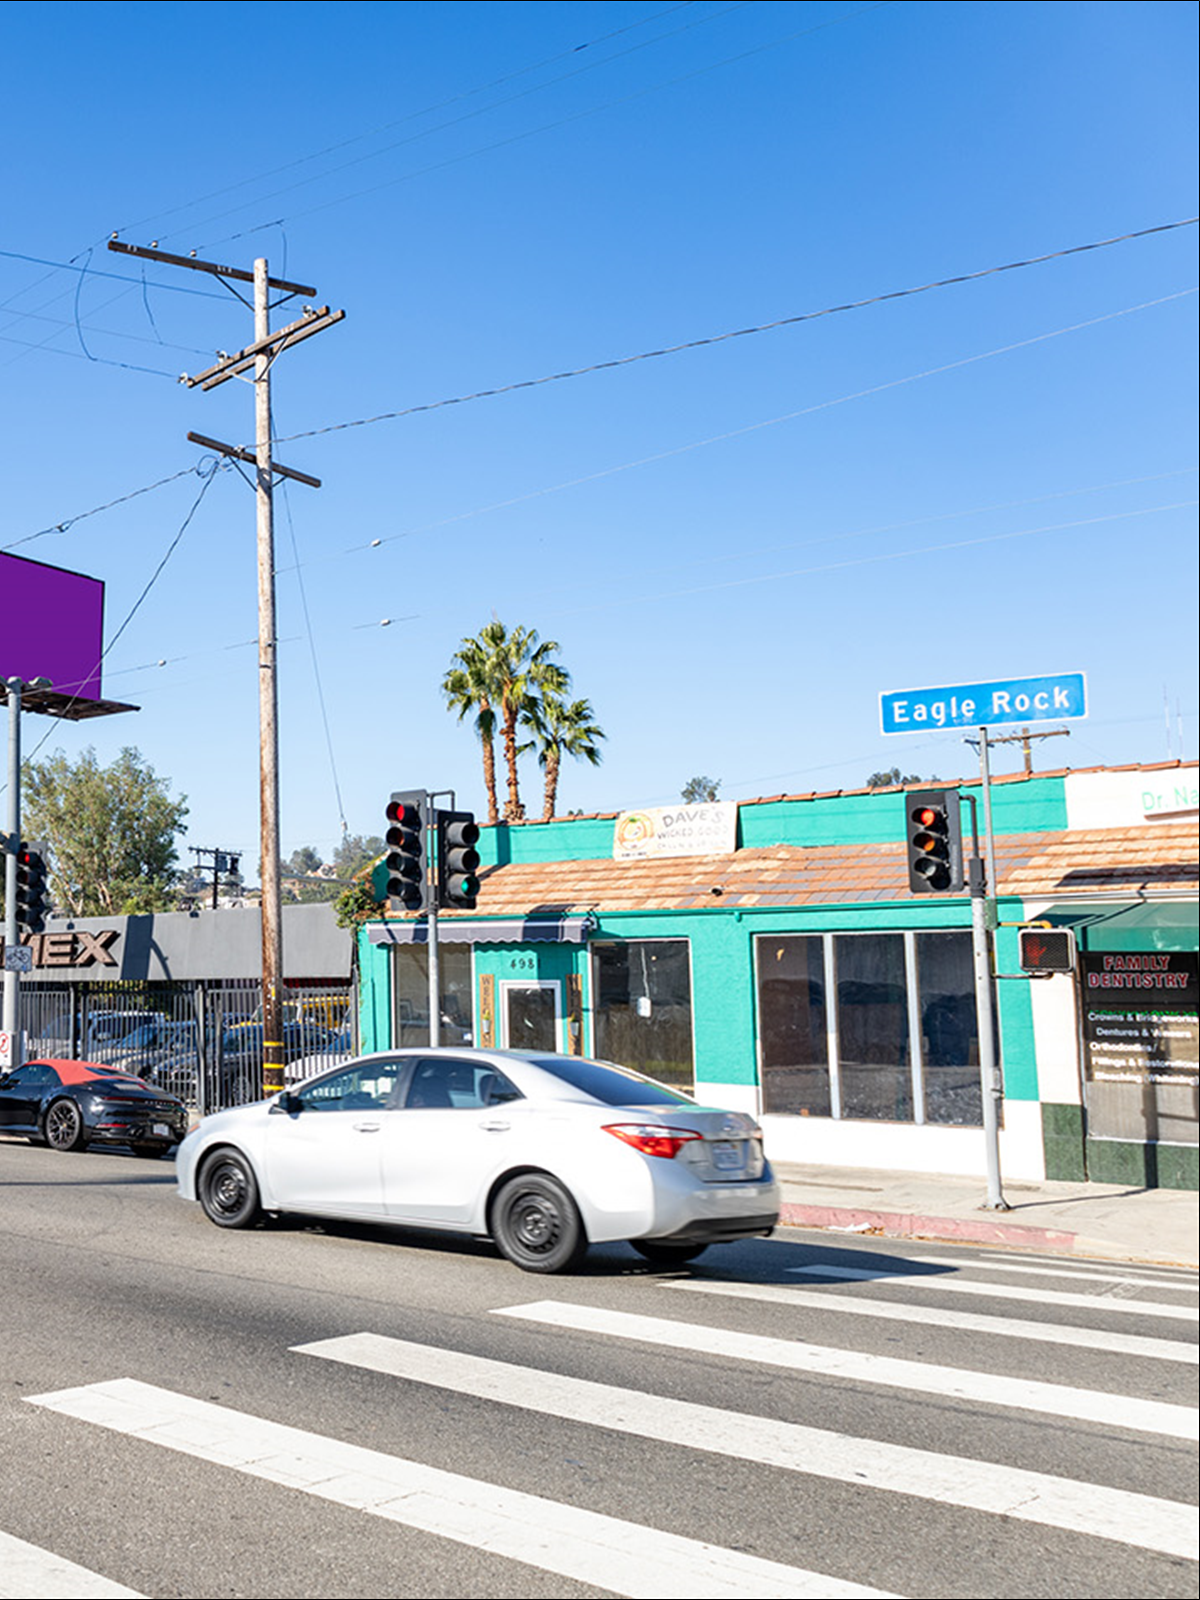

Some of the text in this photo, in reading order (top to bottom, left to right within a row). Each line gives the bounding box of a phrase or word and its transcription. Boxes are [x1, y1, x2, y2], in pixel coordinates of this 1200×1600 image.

[893, 686, 1071, 726] Eagle Rock
[1142, 791, 1169, 811] Dr.
[662, 805, 725, 828] DAVE'S
[1103, 955, 1170, 971] FAMILY
[1087, 972, 1189, 988] DENTISTRY
